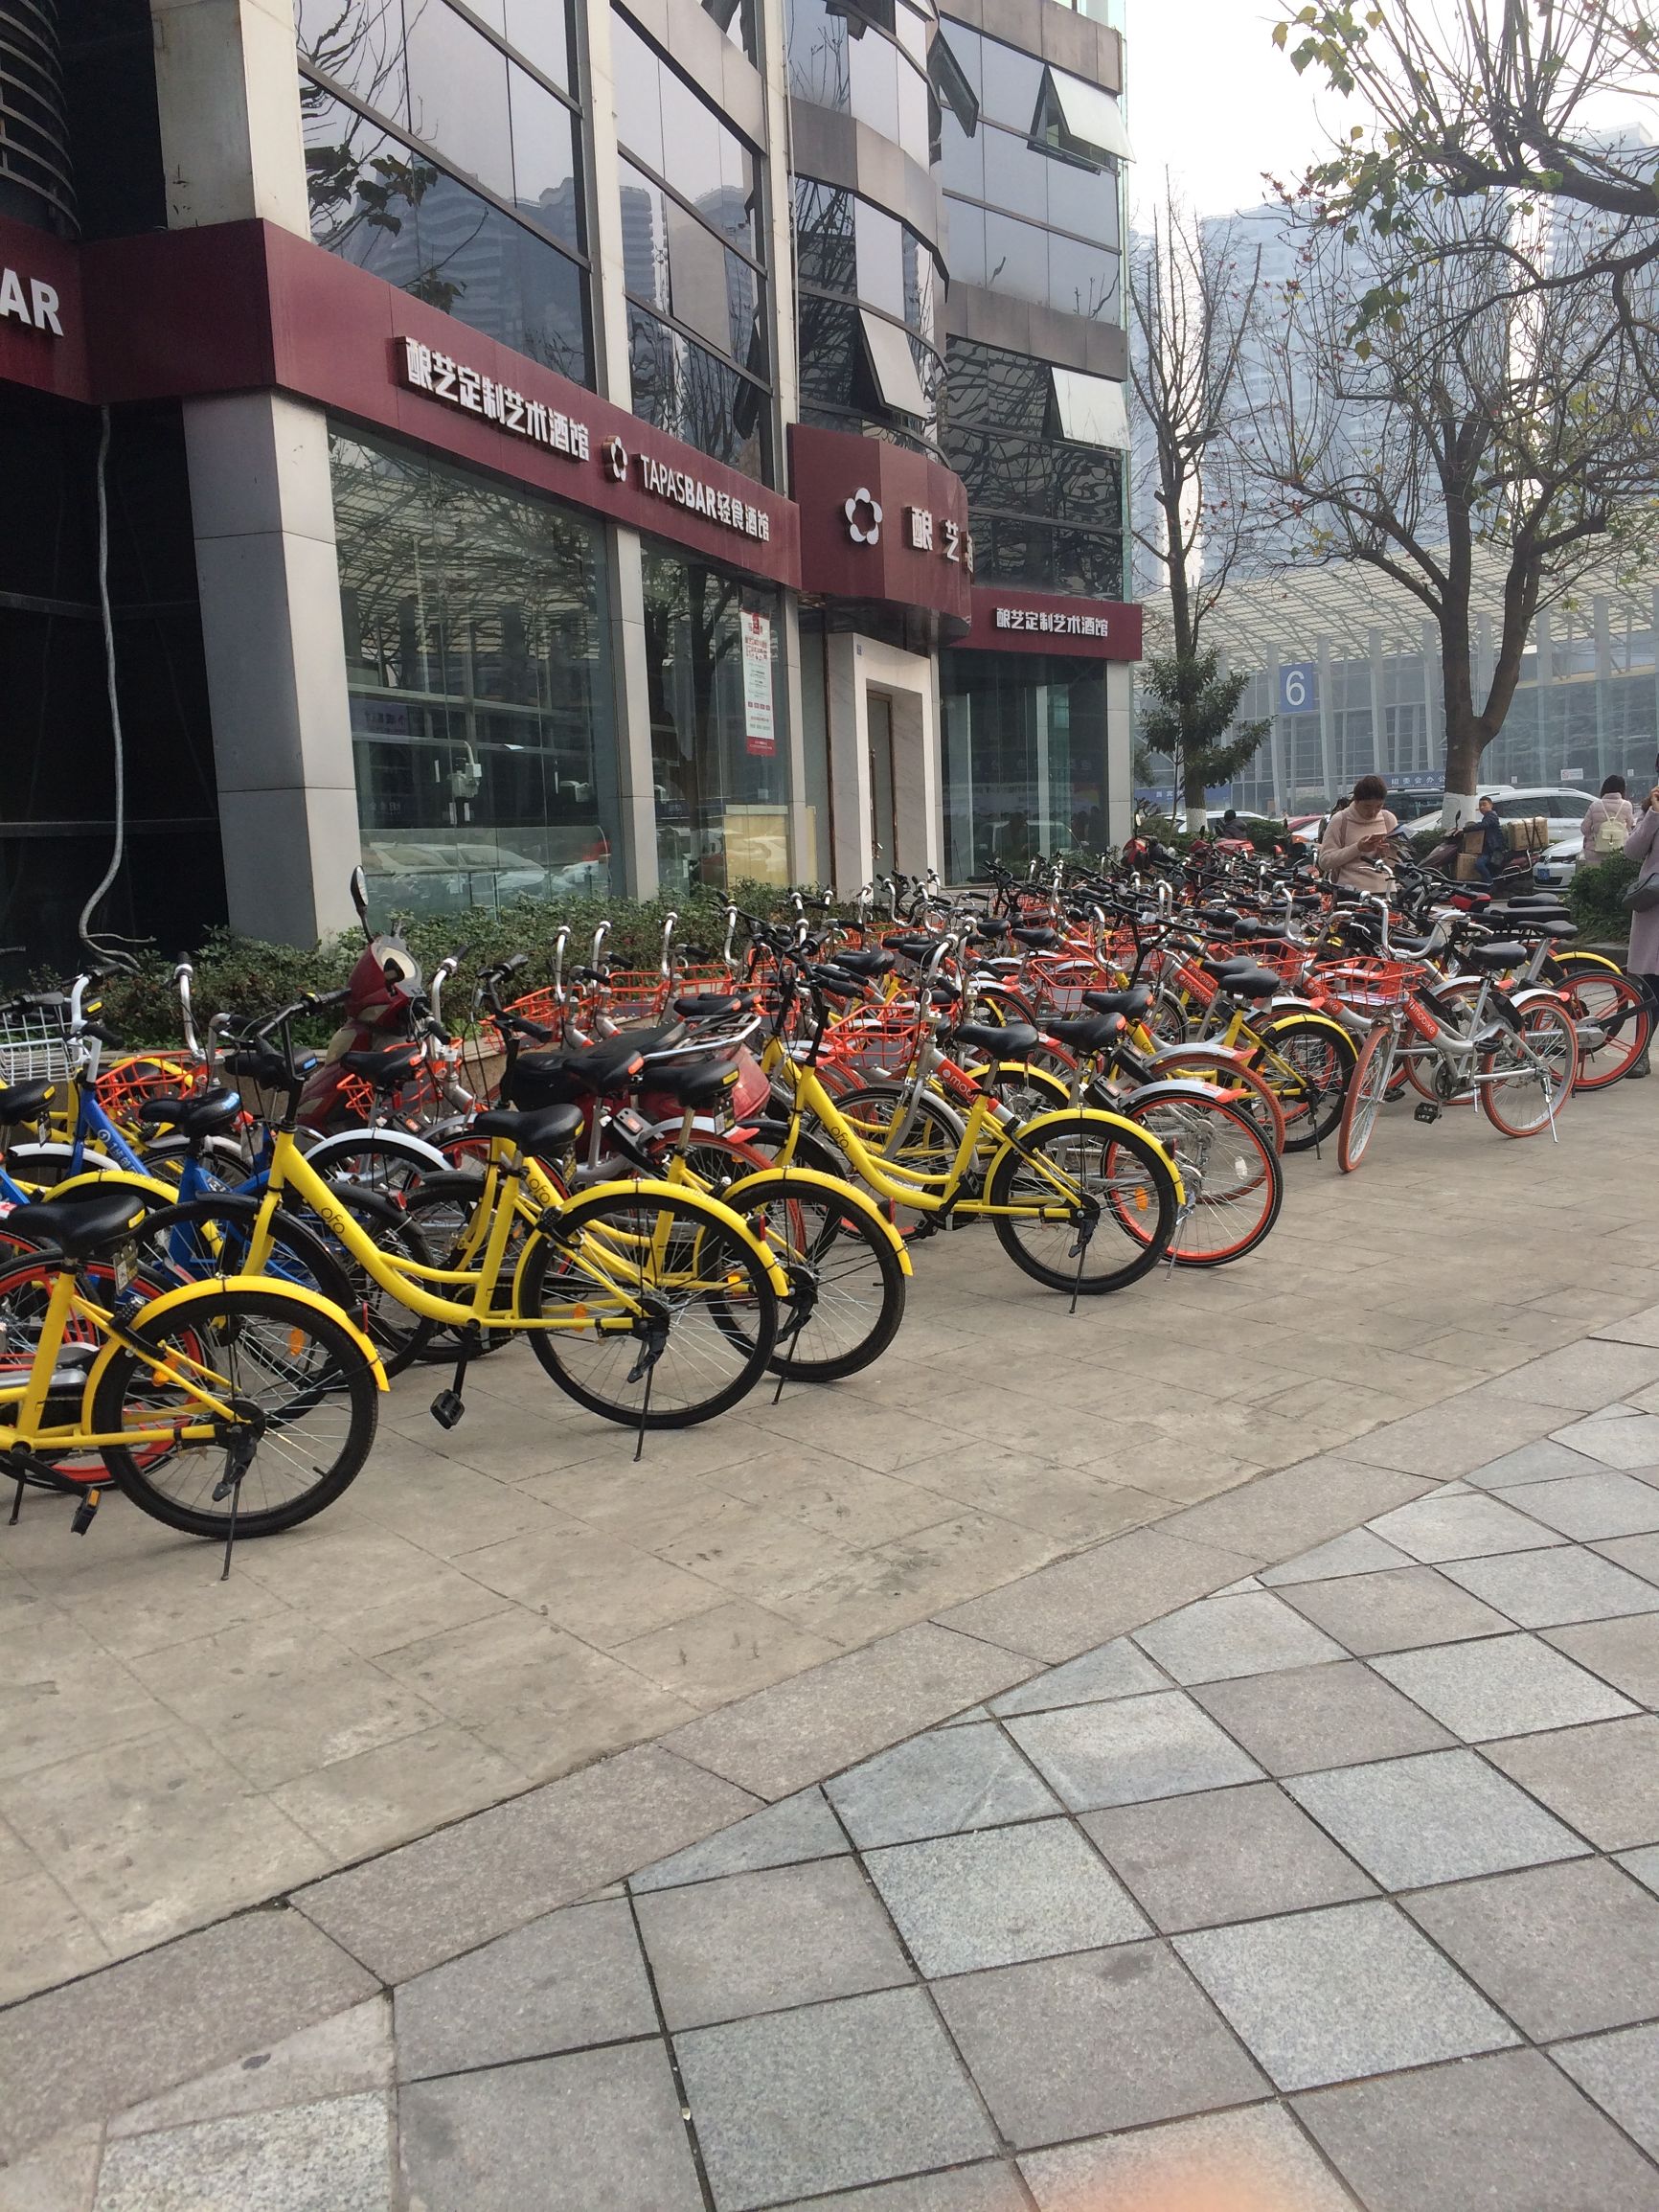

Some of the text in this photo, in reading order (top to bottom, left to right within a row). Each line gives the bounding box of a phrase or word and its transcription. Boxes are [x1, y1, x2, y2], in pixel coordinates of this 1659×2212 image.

[406, 336, 590, 462] 酿艺定制艺术酒馆
[996, 606, 1109, 638] 酿艺定制艺术酒馆
[1285, 671, 1306, 706] 6
[1183, 978, 1211, 1004] mobike
[1413, 1006, 1436, 1035] mobike
[830, 1126, 850, 1150] ofo
[529, 1178, 551, 1204] ofo
[321, 1207, 346, 1235] ofo
